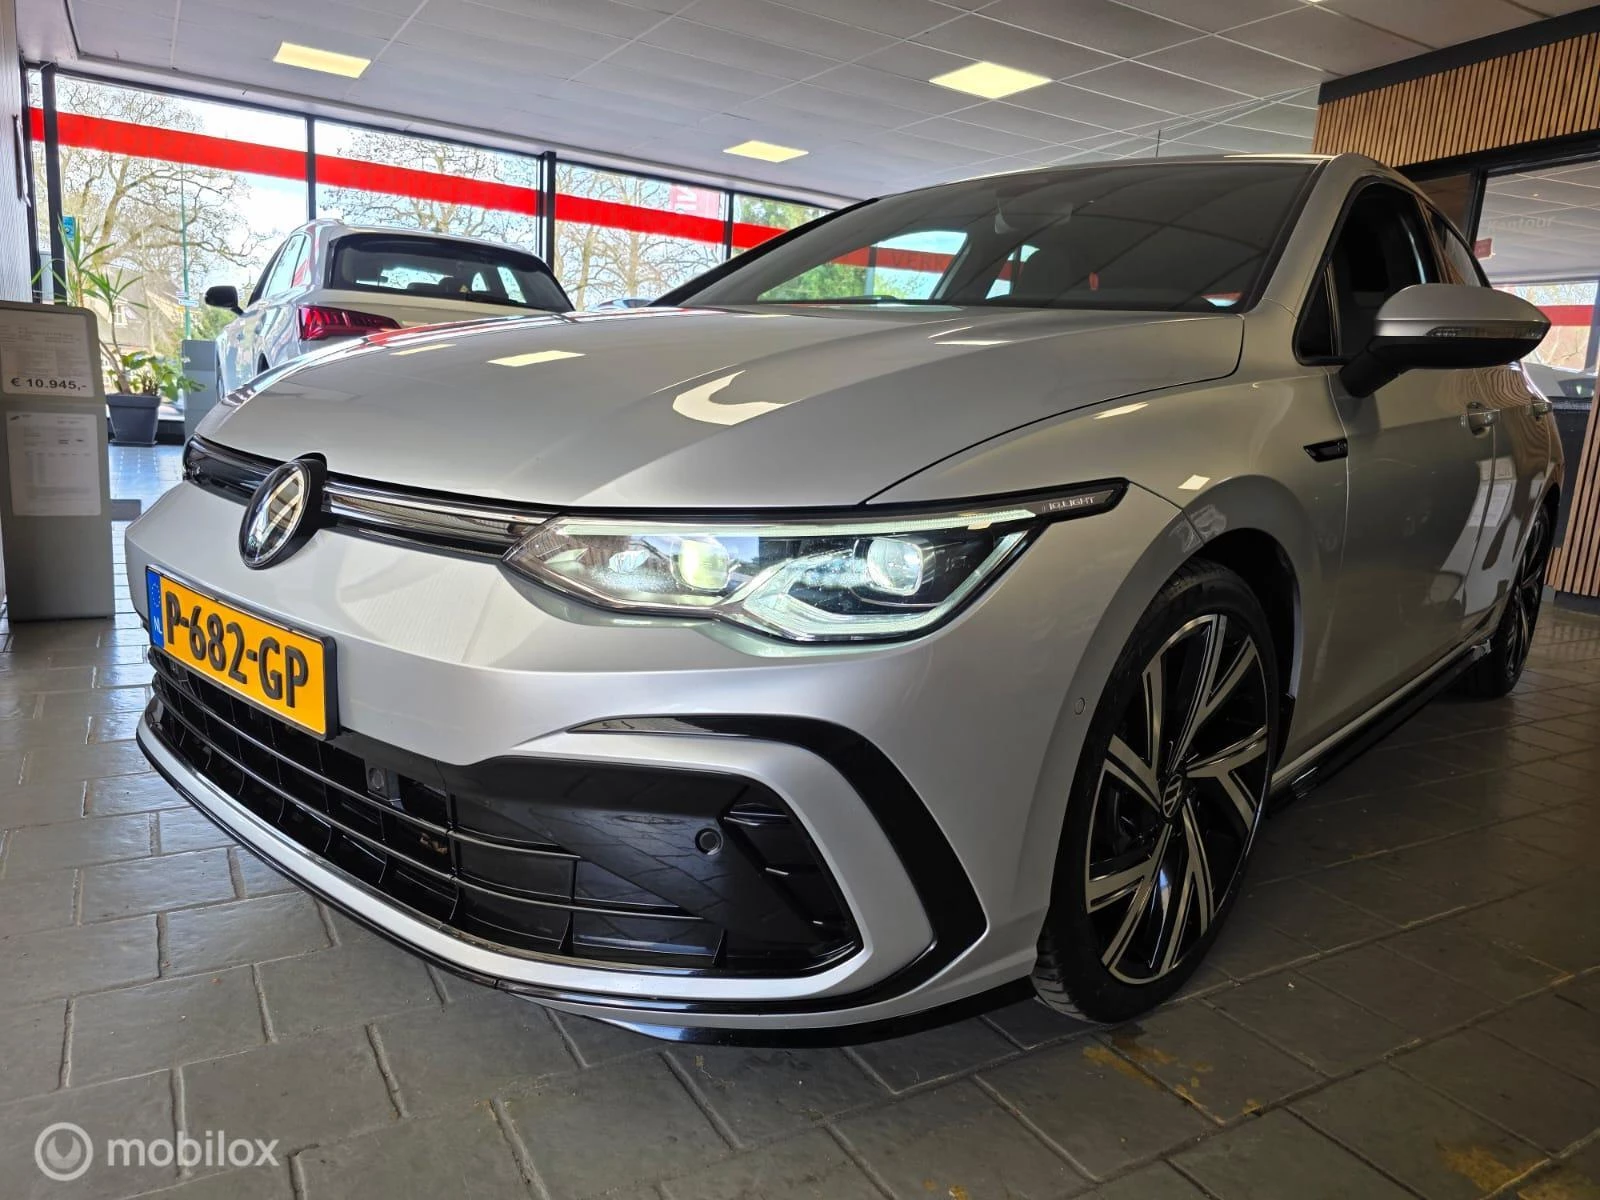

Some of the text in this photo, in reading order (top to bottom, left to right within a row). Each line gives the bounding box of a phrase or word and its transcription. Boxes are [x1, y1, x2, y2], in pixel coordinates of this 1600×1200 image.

[26, 378, 87, 391] 10.945,-
[153, 616, 163, 634] NL
[165, 591, 309, 708] P-682-GP
